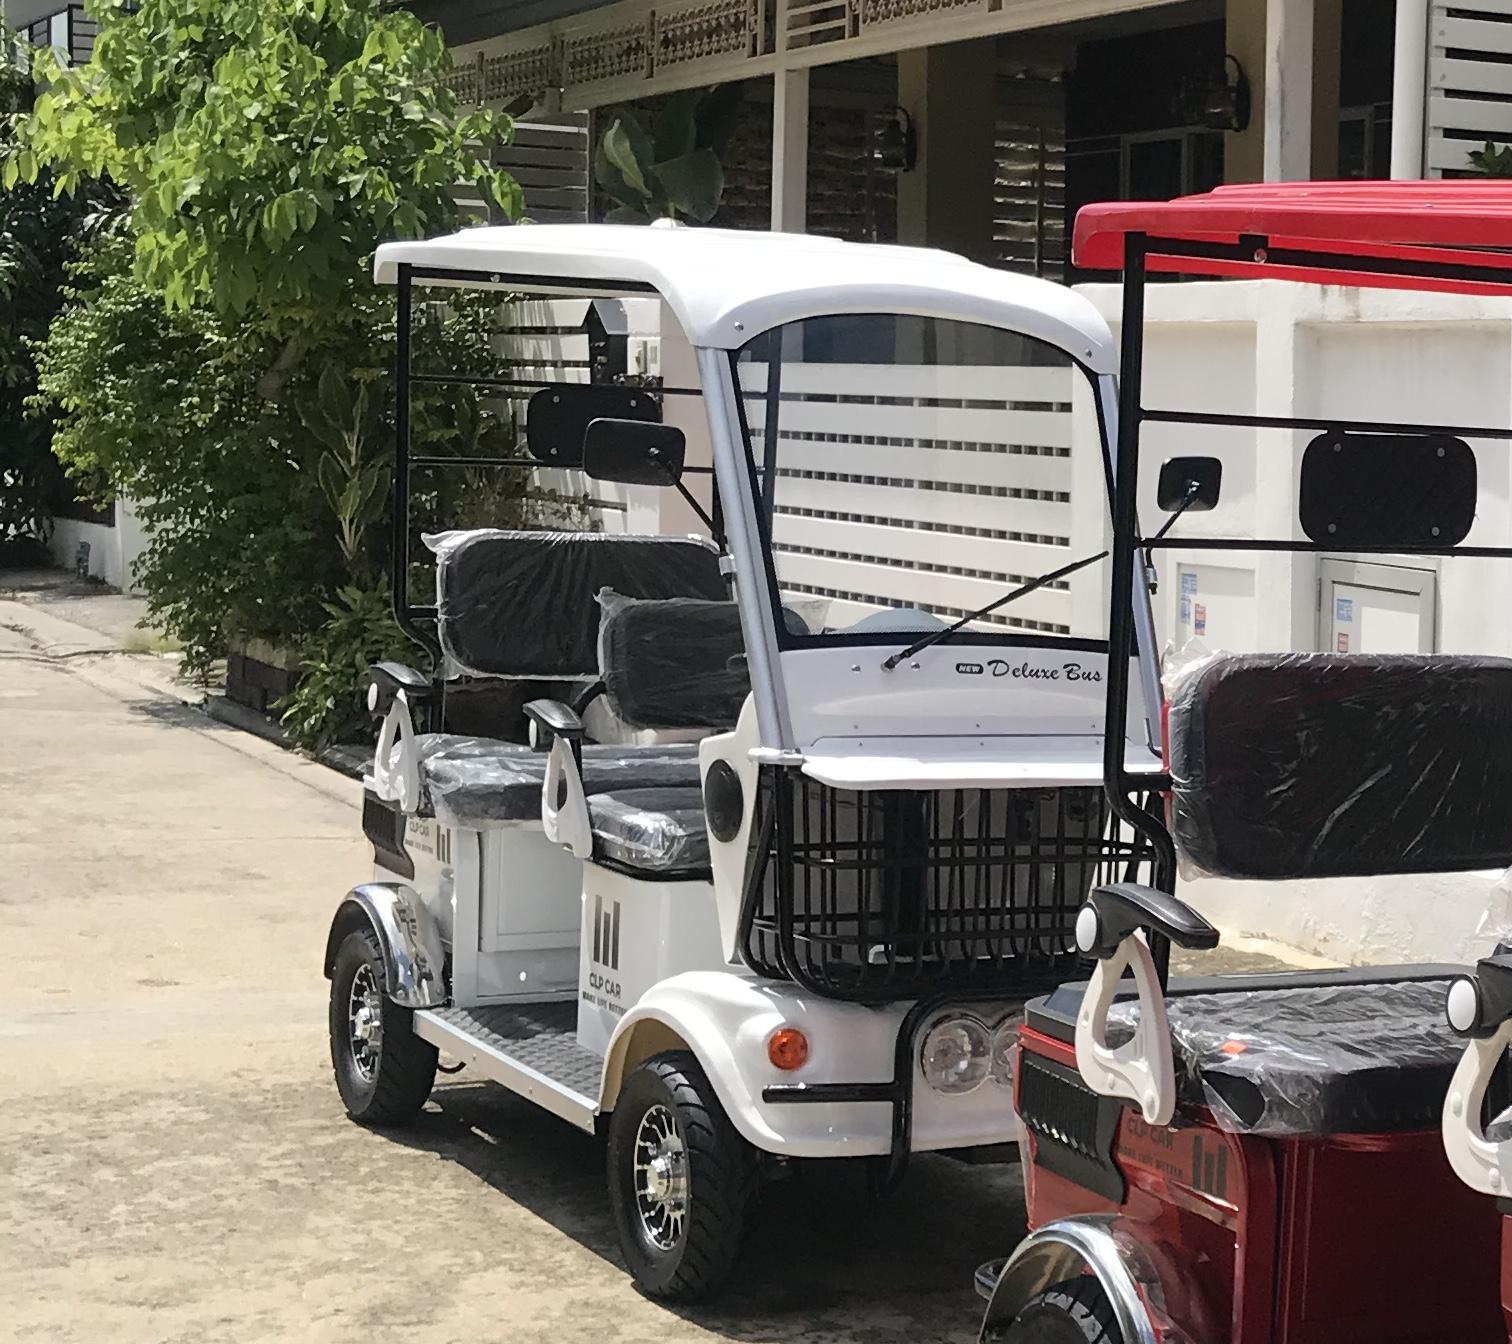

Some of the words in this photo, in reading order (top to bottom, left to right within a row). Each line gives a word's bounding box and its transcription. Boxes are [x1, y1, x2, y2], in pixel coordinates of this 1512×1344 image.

[957, 663, 983, 674] NEW
[987, 659, 1060, 680] Deluxe
[1063, 663, 1102, 682] Bus
[589, 972, 604, 990] CLP
[605, 979, 621, 999] CAR
